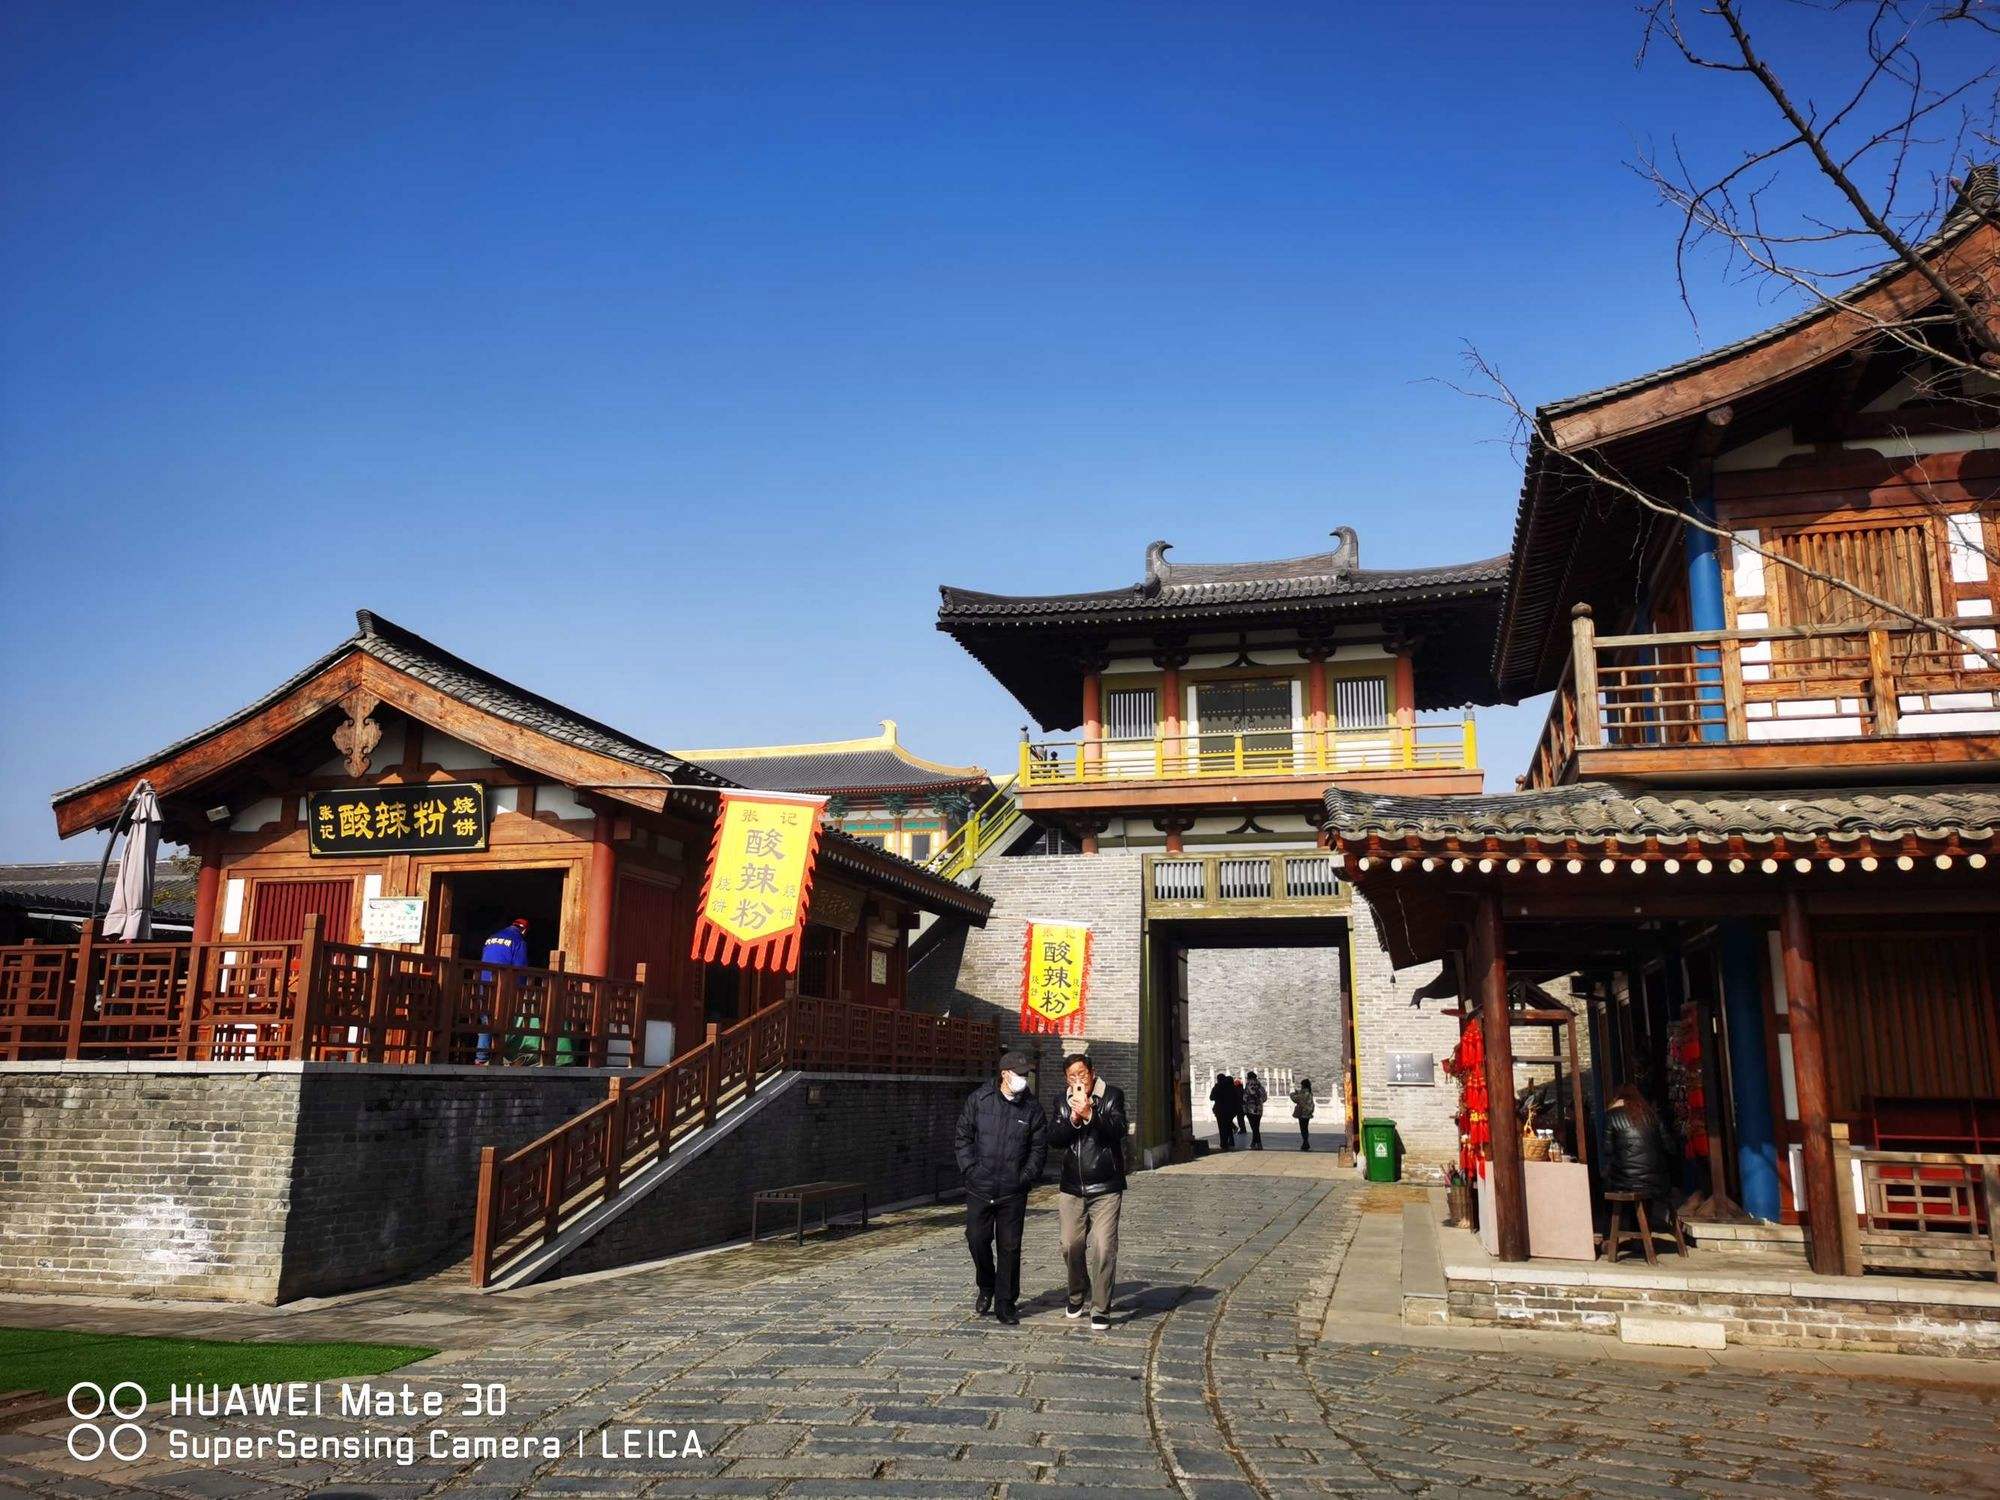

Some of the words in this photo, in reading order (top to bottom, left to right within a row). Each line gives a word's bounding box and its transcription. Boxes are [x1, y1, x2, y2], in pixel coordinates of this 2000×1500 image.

[318, 804, 336, 840] 张记
[337, 798, 448, 840] 酸辣粉
[451, 796, 478, 837] 烧饼
[741, 808, 798, 827] 张记
[730, 828, 785, 930] 酸辣粉
[1040, 940, 1073, 1014] 酸辣粉
